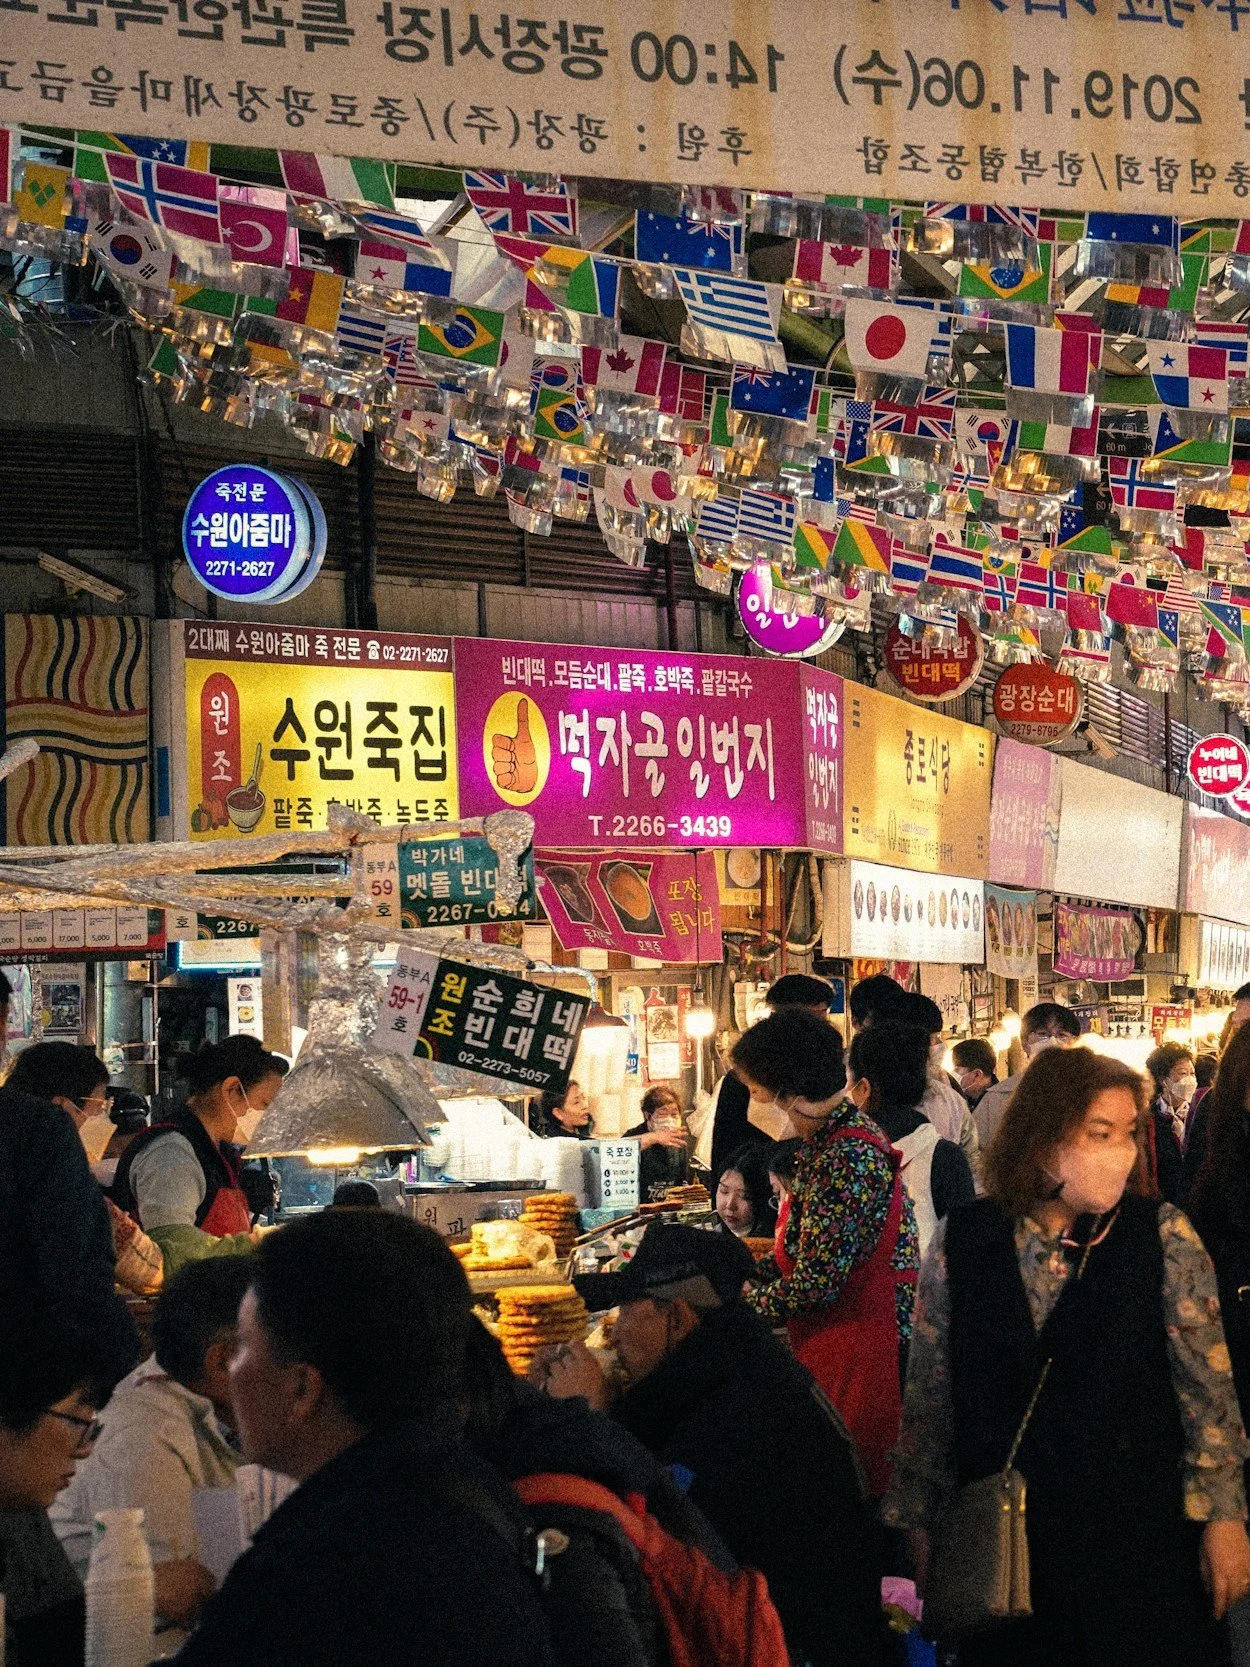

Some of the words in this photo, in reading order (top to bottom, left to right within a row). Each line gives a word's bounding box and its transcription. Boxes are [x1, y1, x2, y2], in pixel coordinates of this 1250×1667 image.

[190, 512, 291, 549] 수원아줌마
[205, 560, 275, 578] 2271-2627
[188, 628, 230, 653] 2대째
[235, 632, 310, 658] 수원아줌마
[332, 636, 361, 661] 전문
[902, 662, 961, 684] 빈대떡
[1001, 684, 1074, 714] 광장순대
[805, 687, 838, 749] 먹자골
[270, 697, 447, 782] 수원죽집
[558, 707, 775, 801] 먹자골일번지
[903, 728, 950, 796] 종로식당
[1197, 764, 1243, 784] 빈대떡
[808, 752, 838, 813] 일번지
[588, 815, 732, 837] T.2266-3439
[366, 860, 397, 875] 동부A
[411, 845, 464, 868] 박가네
[371, 880, 393, 897] 59
[406, 870, 451, 900] 멧돌
[668, 876, 702, 902] 포장
[376, 902, 392, 918] 호
[669, 906, 716, 936] 됩니다
[396, 963, 431, 985] 동부A
[388, 985, 425, 1016] 59-1
[471, 980, 585, 1037] 순희네
[391, 1017, 407, 1034] 호
[464, 1012, 575, 1071] 빈대떡
[457, 1051, 551, 1085] 02-2273-5057
